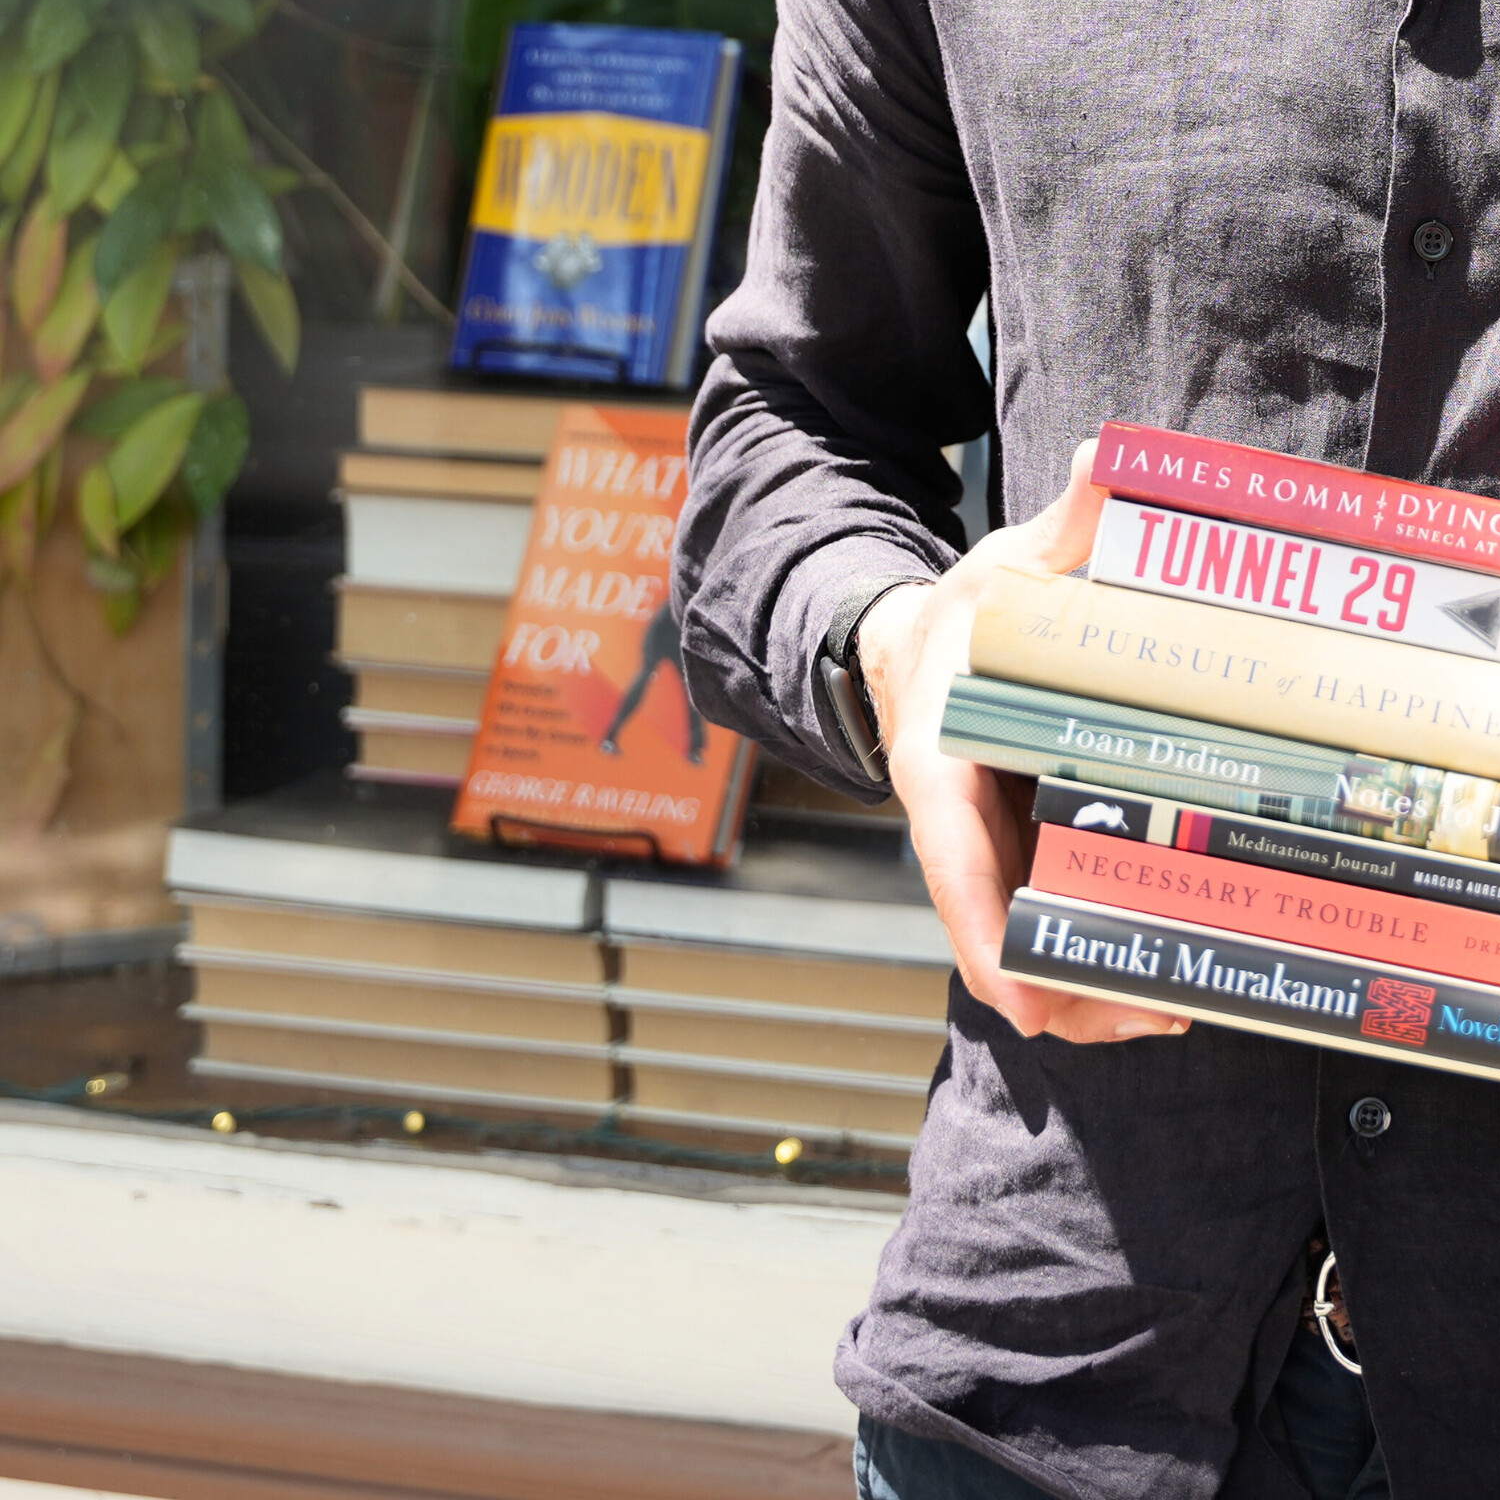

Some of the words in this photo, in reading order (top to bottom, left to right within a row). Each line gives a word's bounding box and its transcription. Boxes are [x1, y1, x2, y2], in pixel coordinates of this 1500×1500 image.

[556, 446, 686, 500] WHAT
[1110, 443, 1232, 489] JAMES
[1246, 470, 1364, 516] ROMM
[540, 504, 674, 561] YOU'R
[1395, 522, 1468, 549] SENECA
[1474, 540, 1498, 555] AT
[518, 563, 664, 621] MADE
[1134, 510, 1322, 616] TUNNEL
[1340, 555, 1416, 633] 29
[502, 622, 600, 675] FOR
[1018, 614, 1063, 642] The
[1078, 623, 1267, 685] PURSUIT
[1276, 673, 1301, 695] of
[1058, 717, 1135, 760] Joan
[1146, 734, 1262, 785] Didion
[1331, 773, 1427, 819] Notes
[1439, 792, 1472, 827] to
[1227, 830, 1328, 864] Meditations
[1333, 850, 1397, 877] Journal
[1413, 870, 1463, 892] MARCUS
[1066, 850, 1261, 908] NECESSARY
[1275, 892, 1429, 944] TROUBLE
[1031, 913, 1163, 978] Haruki
[1169, 941, 1362, 1018] Murakami
